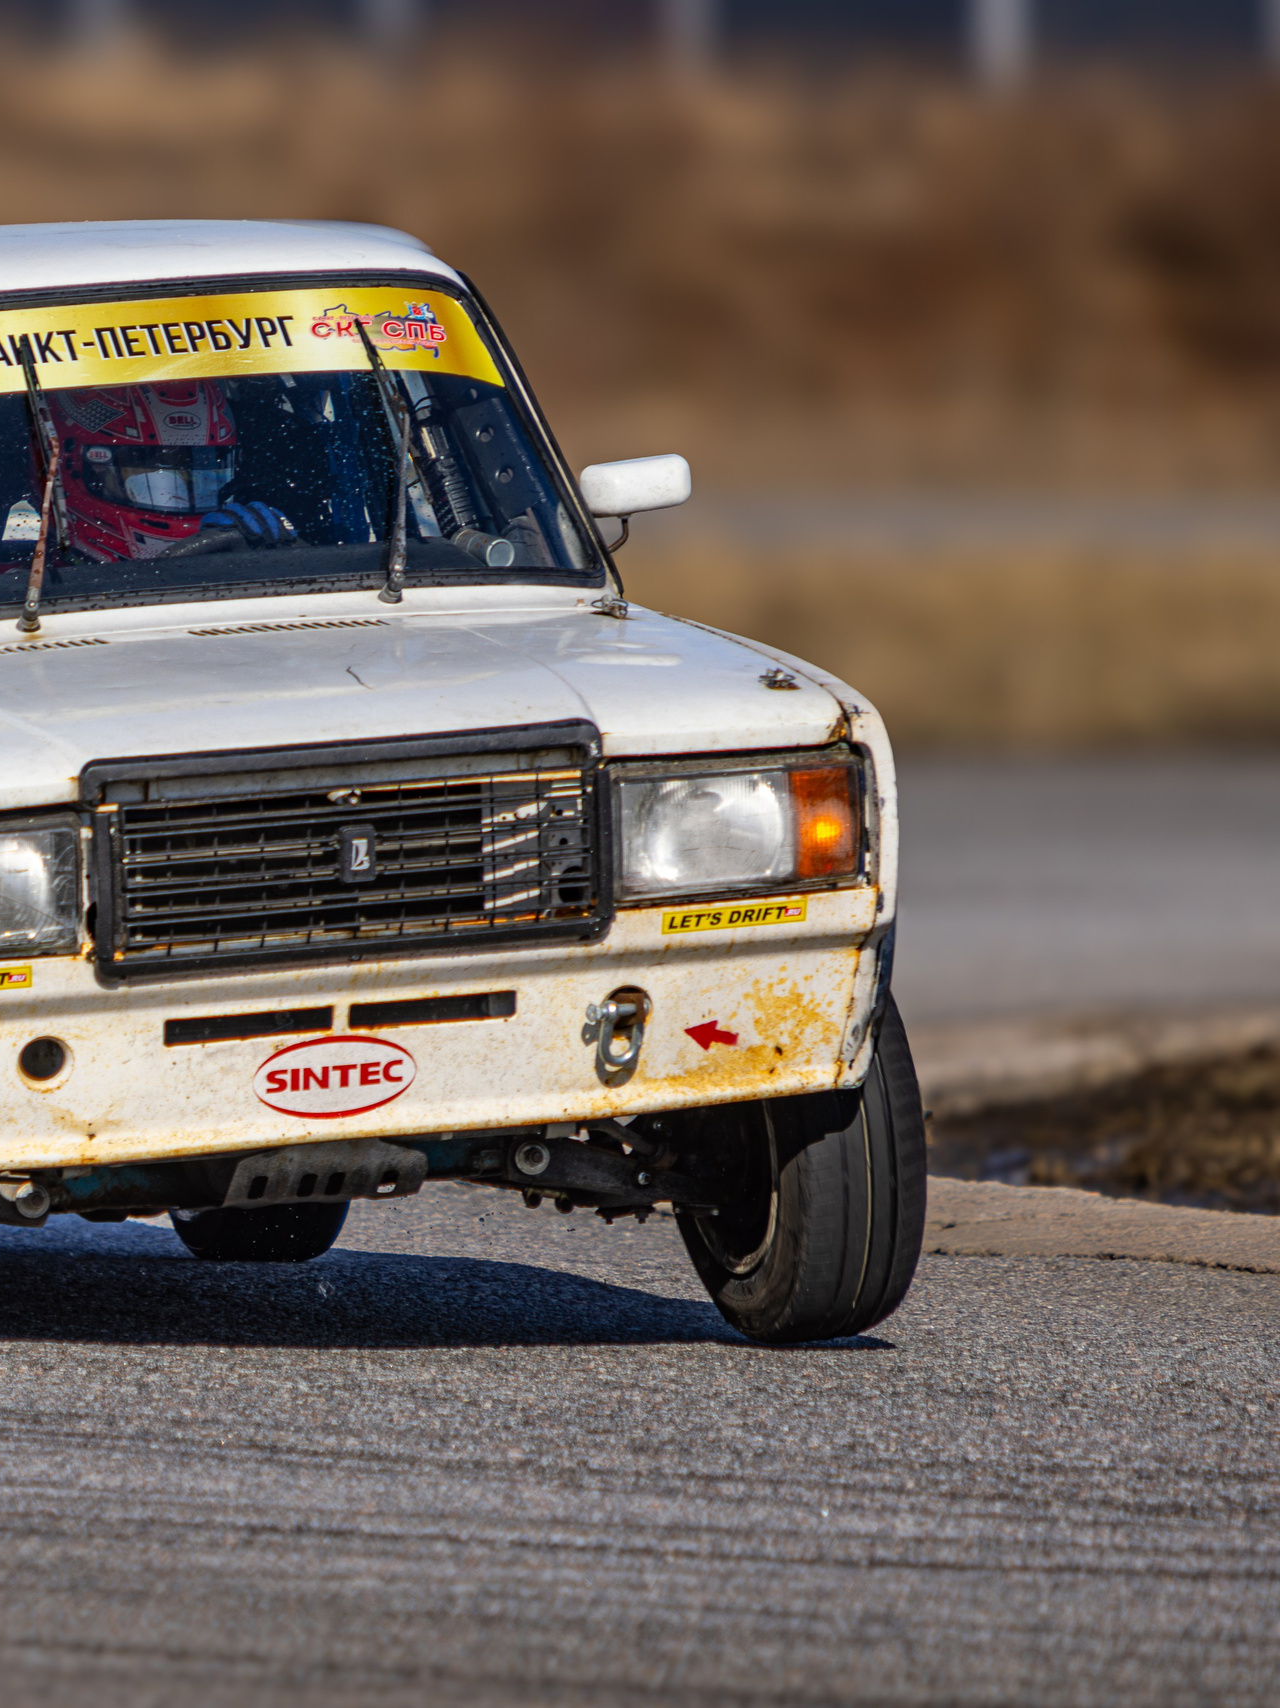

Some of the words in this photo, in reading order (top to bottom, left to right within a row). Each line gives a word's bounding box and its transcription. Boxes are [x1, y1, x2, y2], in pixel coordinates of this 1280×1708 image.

[382, 320, 447, 342] СПБ
[169, 415, 198, 426] BELL
[88, 451, 109, 459] BELL
[668, 911, 723, 930] LET'S
[266, 1059, 404, 1094] SINTEC
